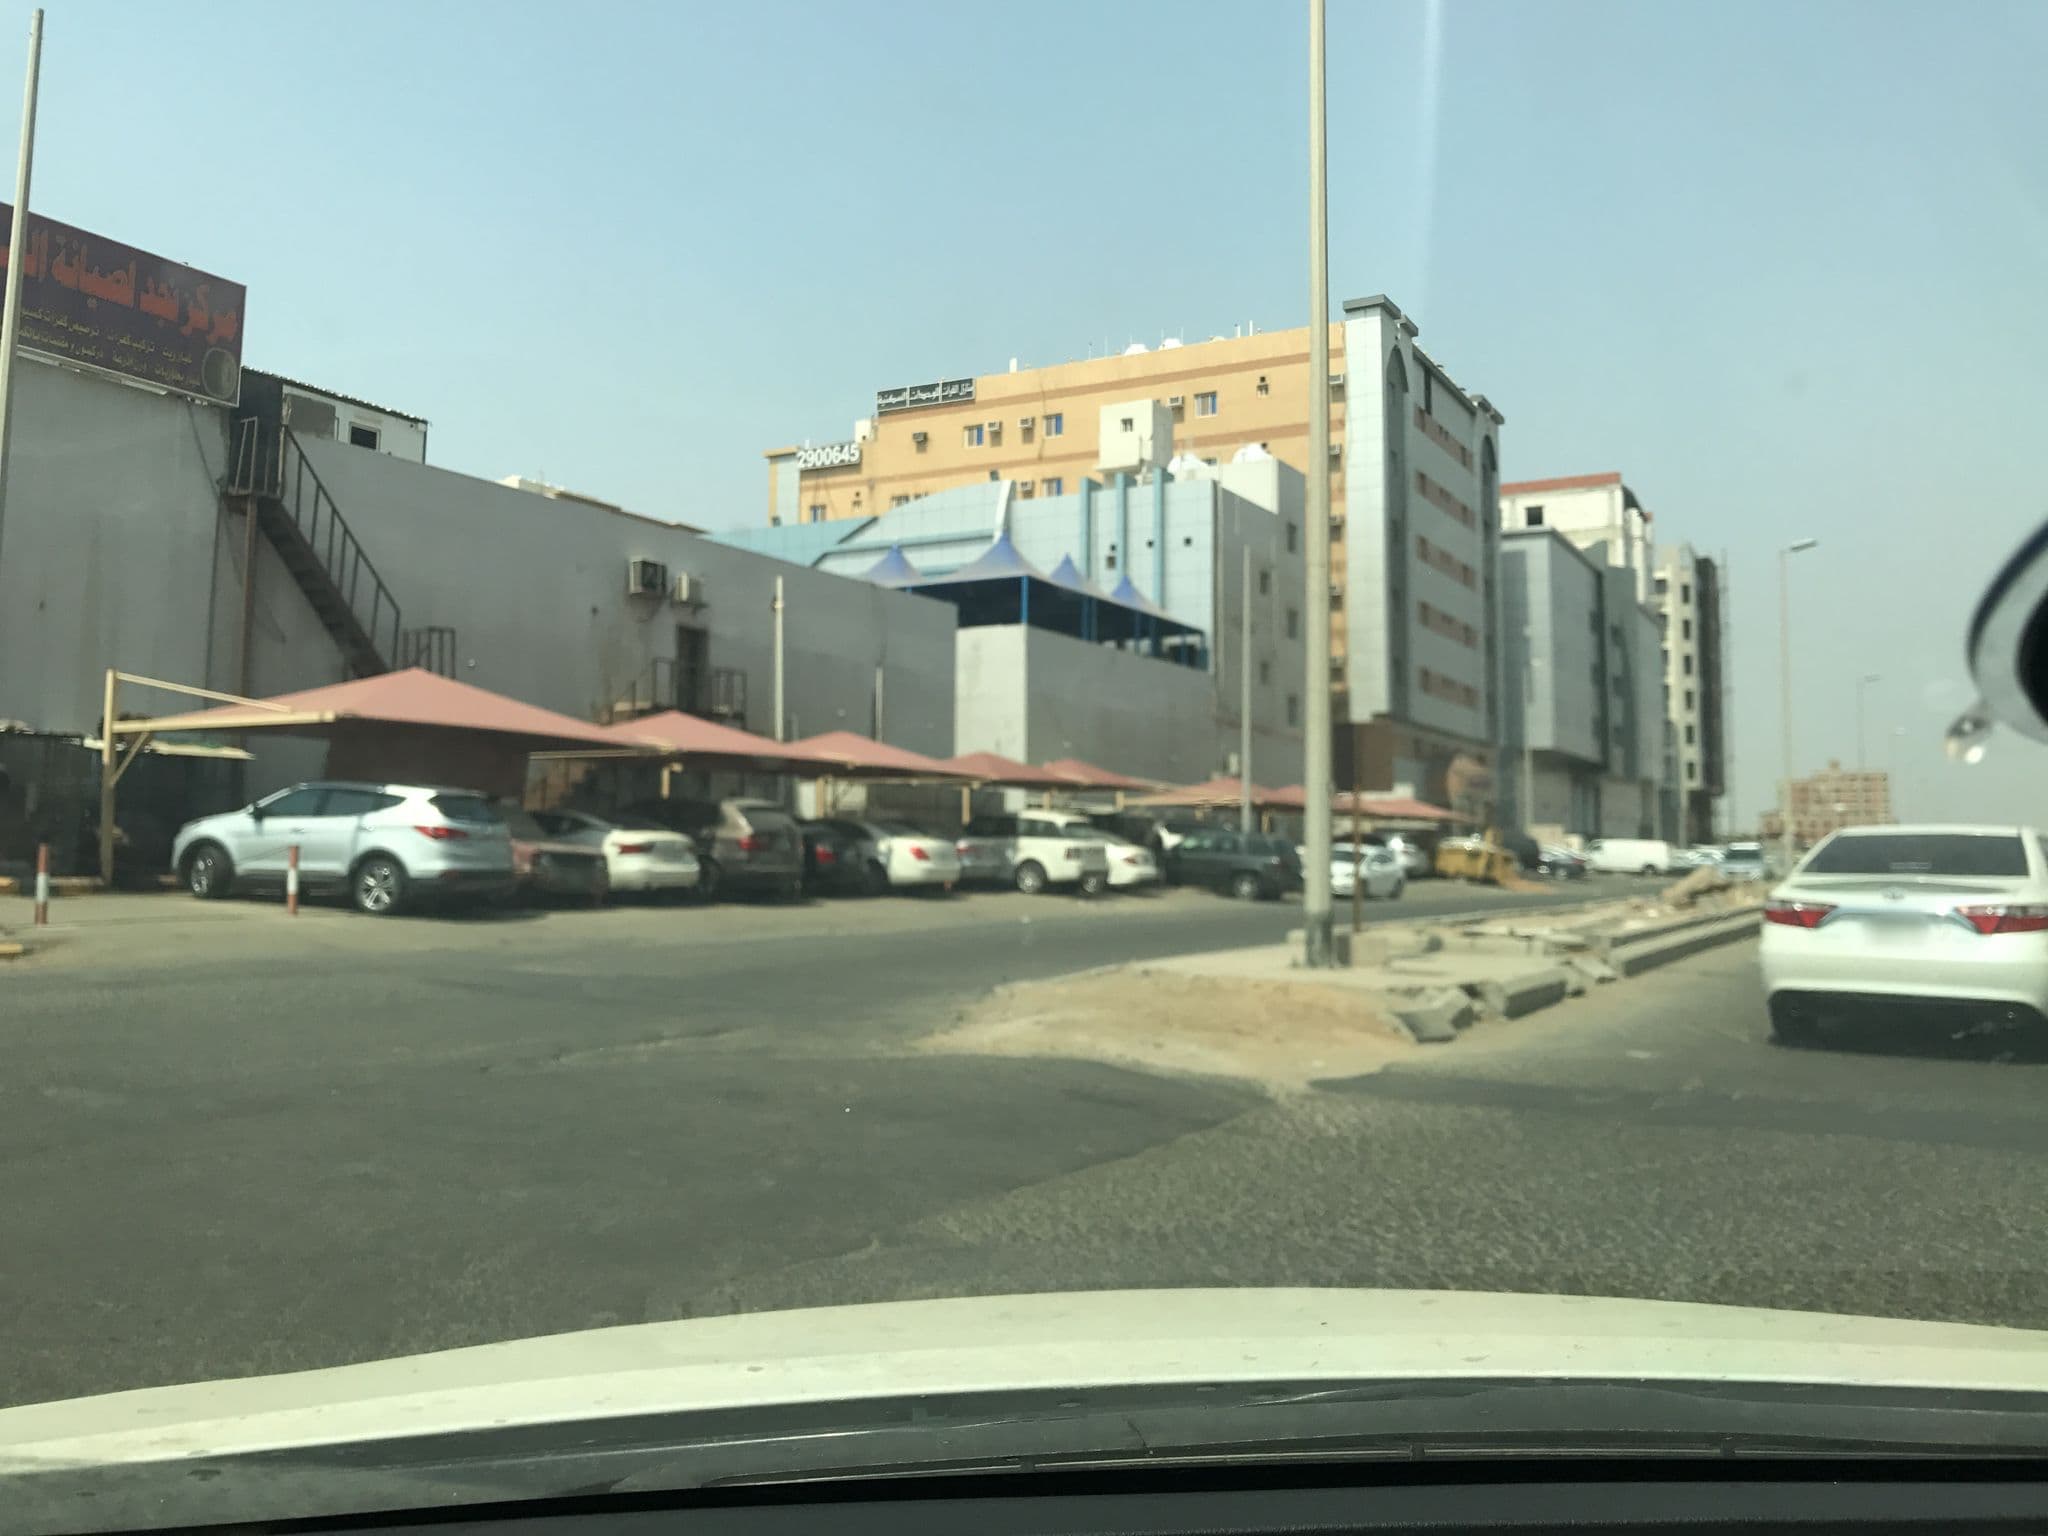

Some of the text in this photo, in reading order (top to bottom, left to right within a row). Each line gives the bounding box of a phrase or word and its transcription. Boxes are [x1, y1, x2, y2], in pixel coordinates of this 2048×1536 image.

[52, 233, 136, 311] لصيانة
[180, 284, 238, 345] مركز
[797, 443, 861, 469] 2900645
